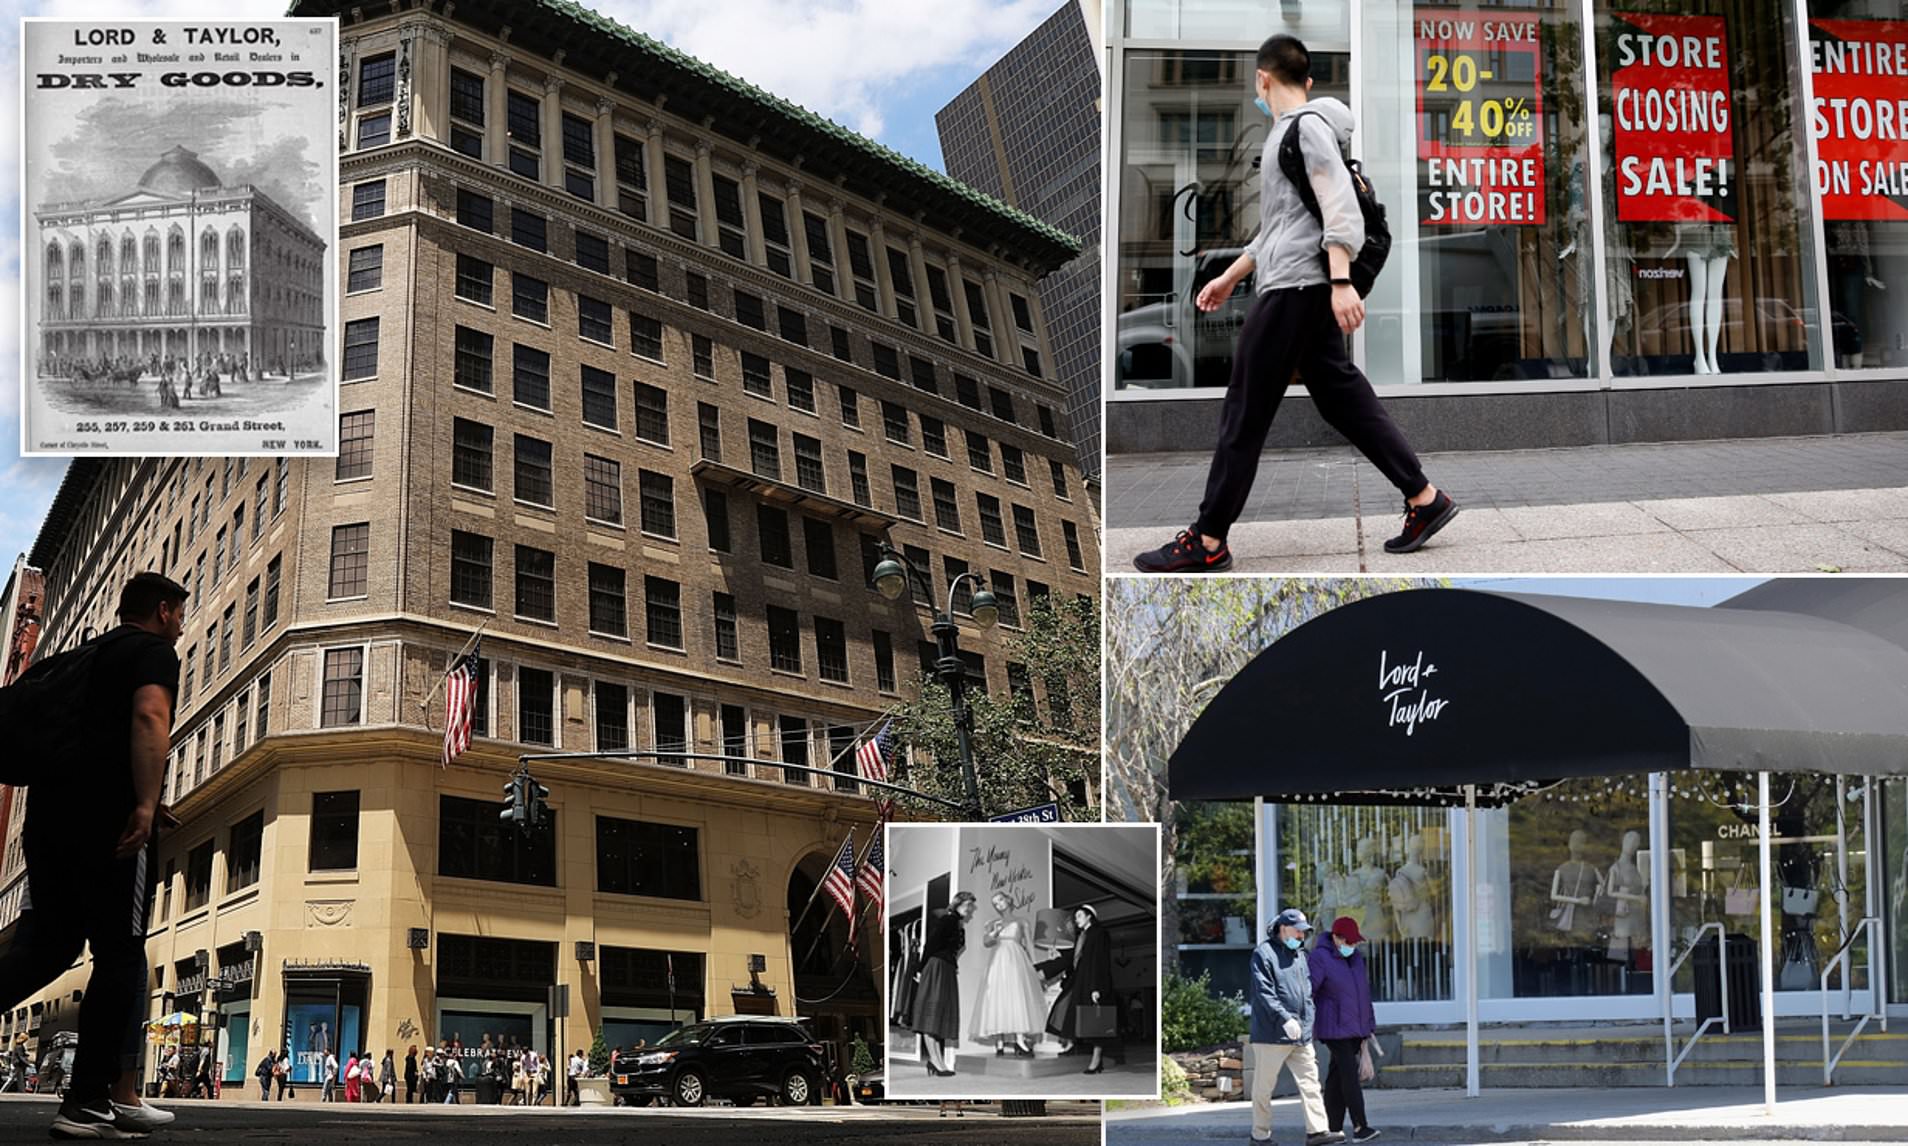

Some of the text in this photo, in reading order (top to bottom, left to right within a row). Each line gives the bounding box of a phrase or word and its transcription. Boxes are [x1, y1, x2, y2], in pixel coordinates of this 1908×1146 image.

[75, 27, 281, 48] LORD & TAYLOR,
[1420, 20, 1536, 42] NOW SAVE
[111, 54, 128, 63] and
[188, 53, 205, 62] and
[291, 52, 300, 61] in
[1617, 33, 1722, 69] STORE
[1810, 40, 1908, 75] ENTIRE
[36, 71, 324, 89] DRY GOODS,
[1426, 55, 1493, 92] 20-
[1617, 87, 1728, 133] CLOSING
[1504, 121, 1533, 137] OFF
[1428, 158, 1536, 187] ENTIRE
[1621, 155, 1729, 197] SALE!
[1818, 160, 1850, 196] ON
[1428, 191, 1535, 221] STORE!
[76, 422, 102, 434] 255,
[105, 422, 130, 434] 257,
[133, 422, 155, 432] 259
[159, 421, 170, 432] &
[199, 421, 240, 432] Grand
[243, 420, 286, 432] Street,
[262, 440, 286, 450] NEW
[1379, 650, 1423, 690] Lord
[1383, 689, 1450, 736] Taylor
[1041, 809, 1054, 822] St
[1718, 823, 1782, 839] CHANL
